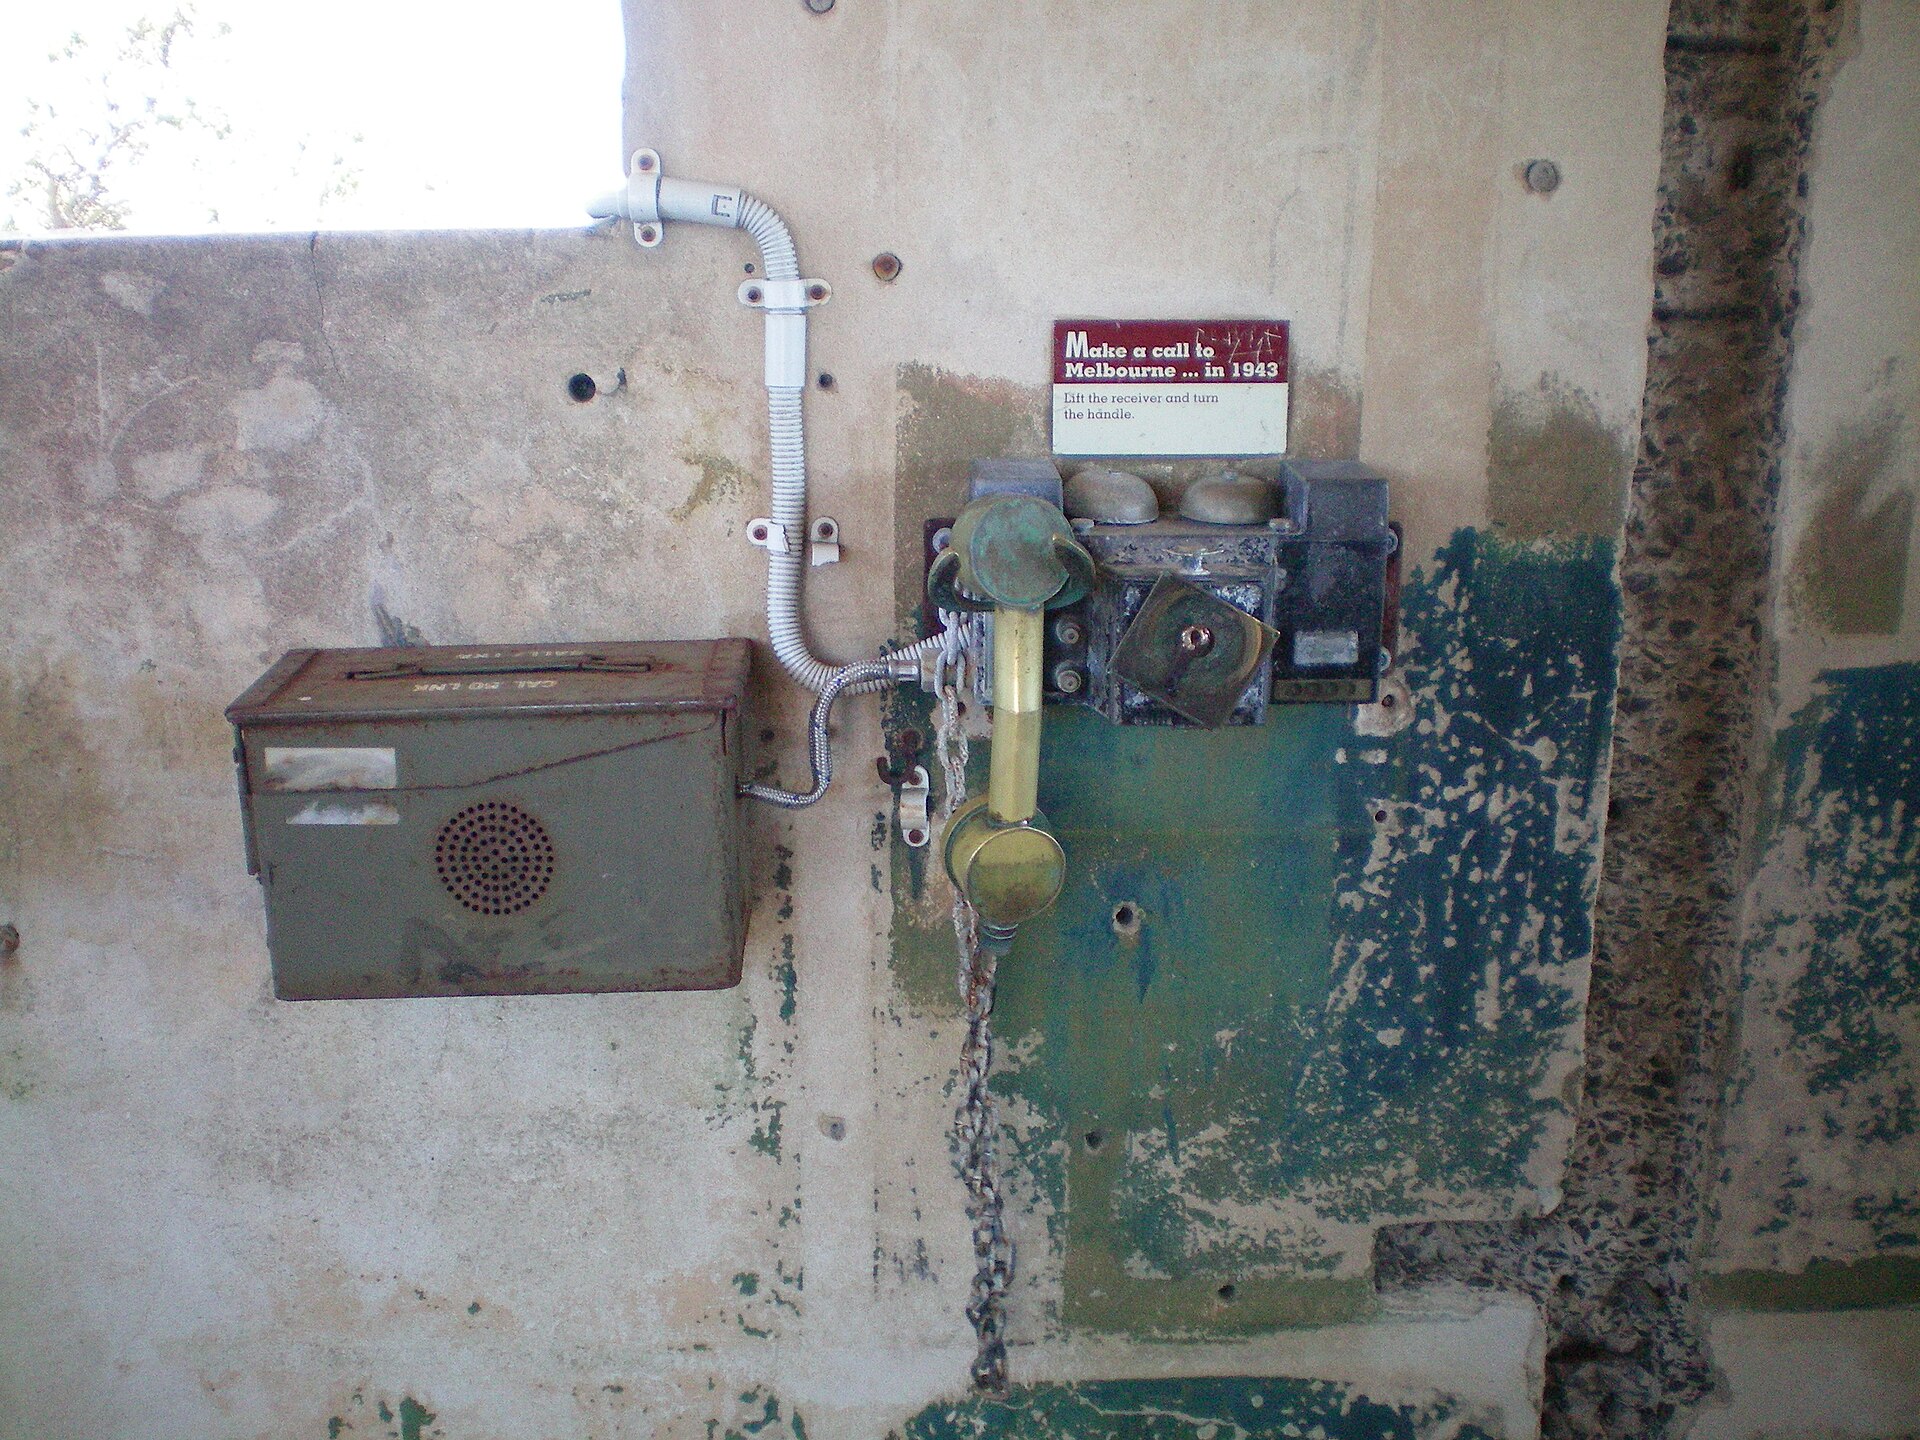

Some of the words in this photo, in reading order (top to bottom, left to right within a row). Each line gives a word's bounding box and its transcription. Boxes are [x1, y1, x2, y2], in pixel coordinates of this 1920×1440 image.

[1065, 331, 1128, 359] Make
[1132, 346, 1147, 359] a
[1152, 343, 1190, 359] call
[1195, 343, 1215, 359] to
[1065, 362, 1177, 378] Melbourne
[1204, 362, 1225, 378] in
[1232, 361, 1279, 378] 1943
[1064, 392, 1085, 404] Lift
[1088, 392, 1108, 404] the
[1112, 393, 1163, 404] receiver
[1166, 392, 1190, 404] and
[1193, 393, 1219, 404] turn
[1064, 408, 1084, 420] the
[1088, 408, 1135, 420] handle.
